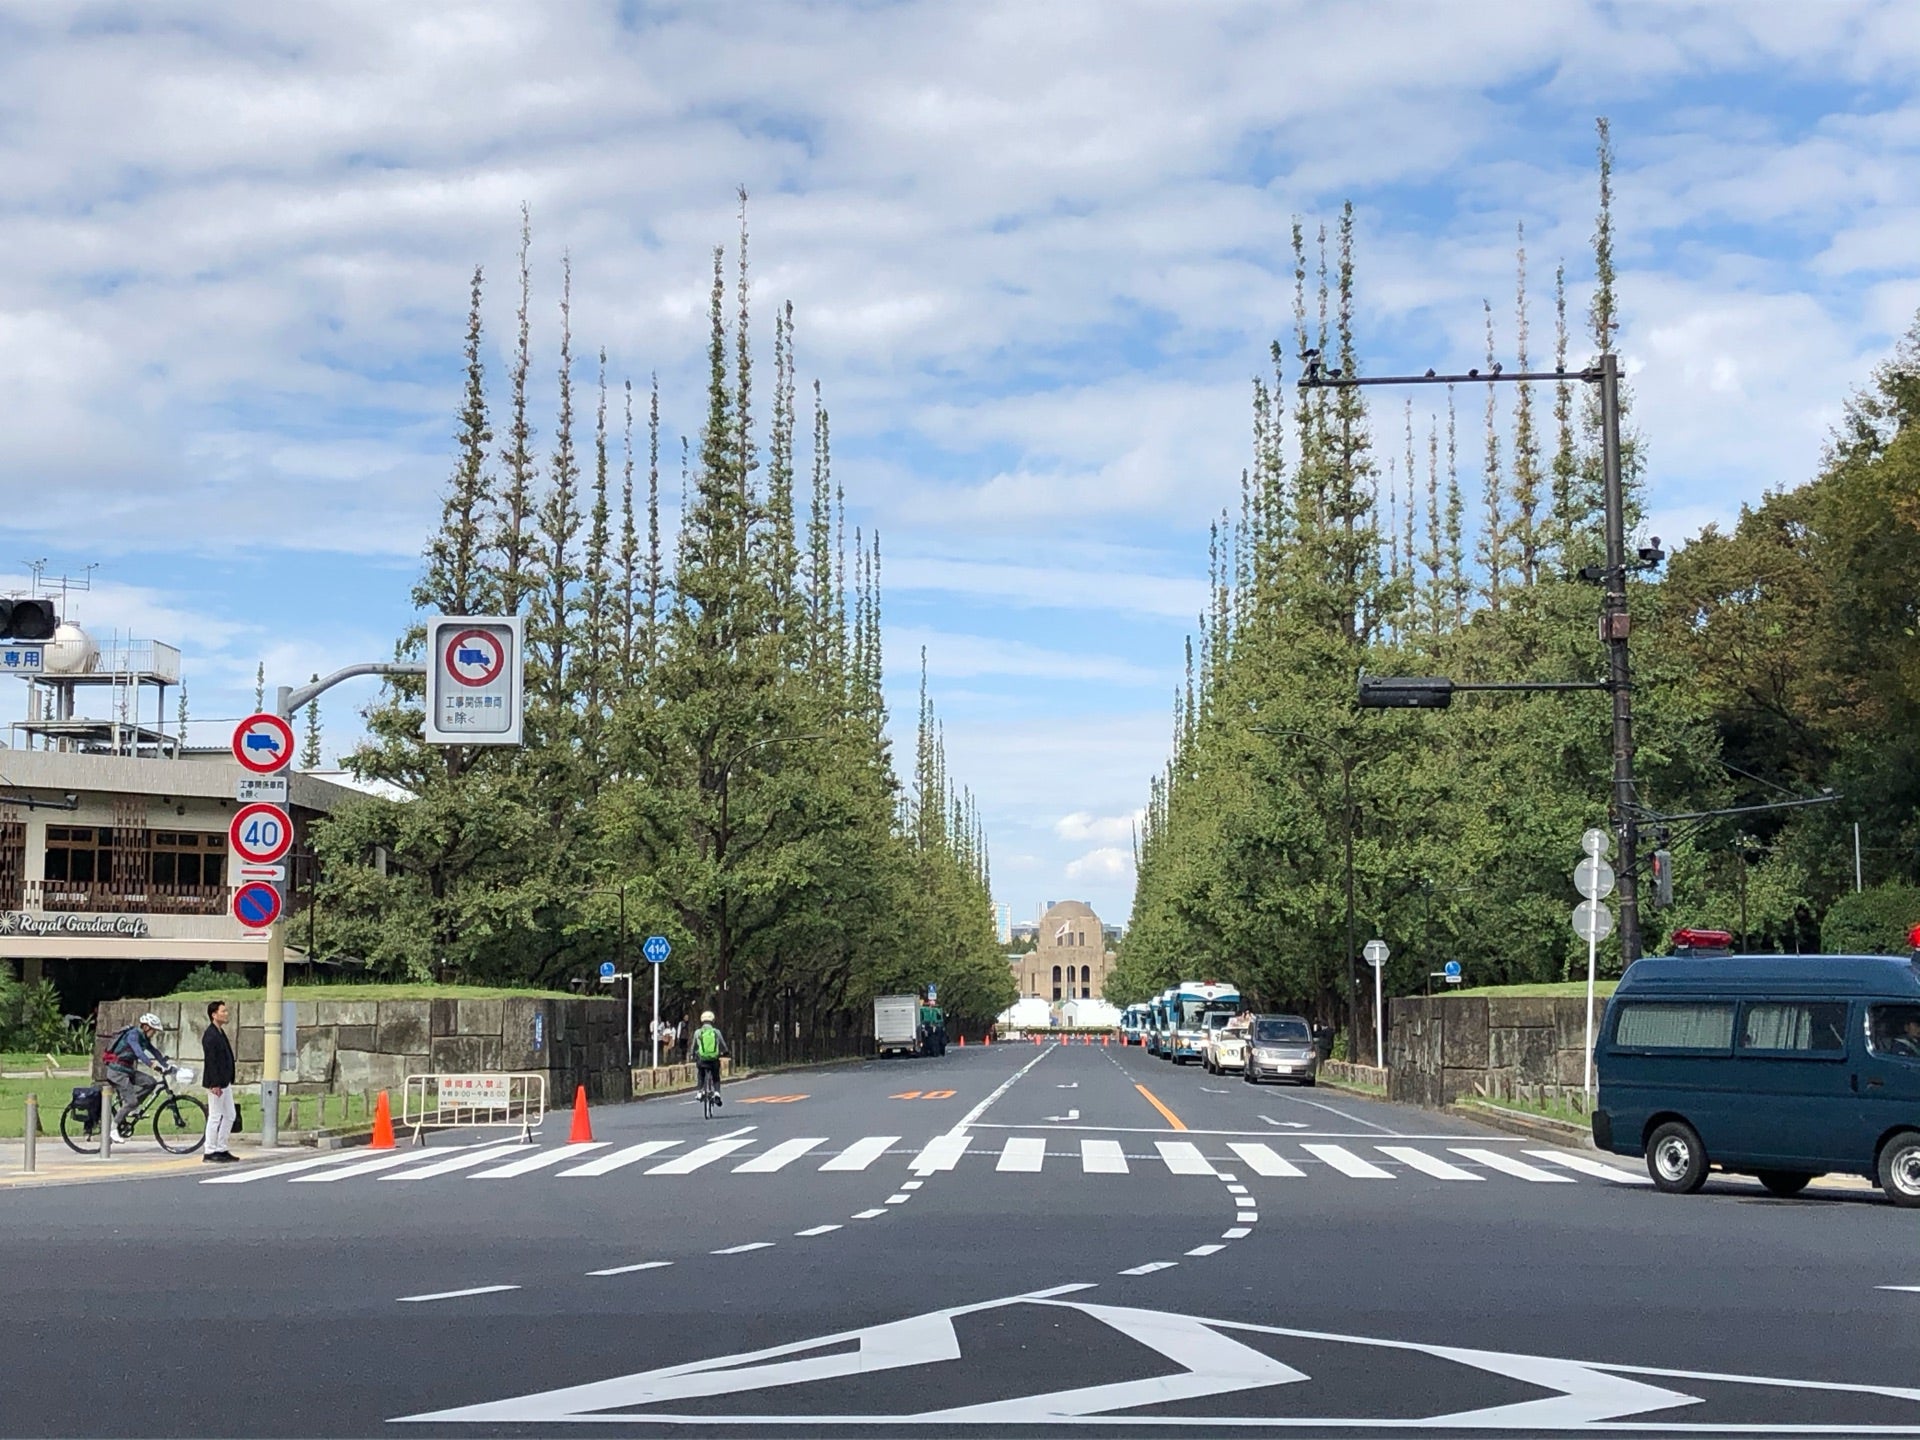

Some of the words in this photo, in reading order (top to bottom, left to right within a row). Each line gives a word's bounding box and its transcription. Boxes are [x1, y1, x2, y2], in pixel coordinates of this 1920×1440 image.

[0, 651, 39, 667] 専用
[445, 696, 502, 708] 工事関係車両
[446, 711, 475, 724] を除く
[244, 820, 278, 847] 40
[19, 914, 64, 935] Royal
[66, 914, 115, 932] Garden
[116, 917, 148, 938] Cafe
[647, 943, 667, 954] 414
